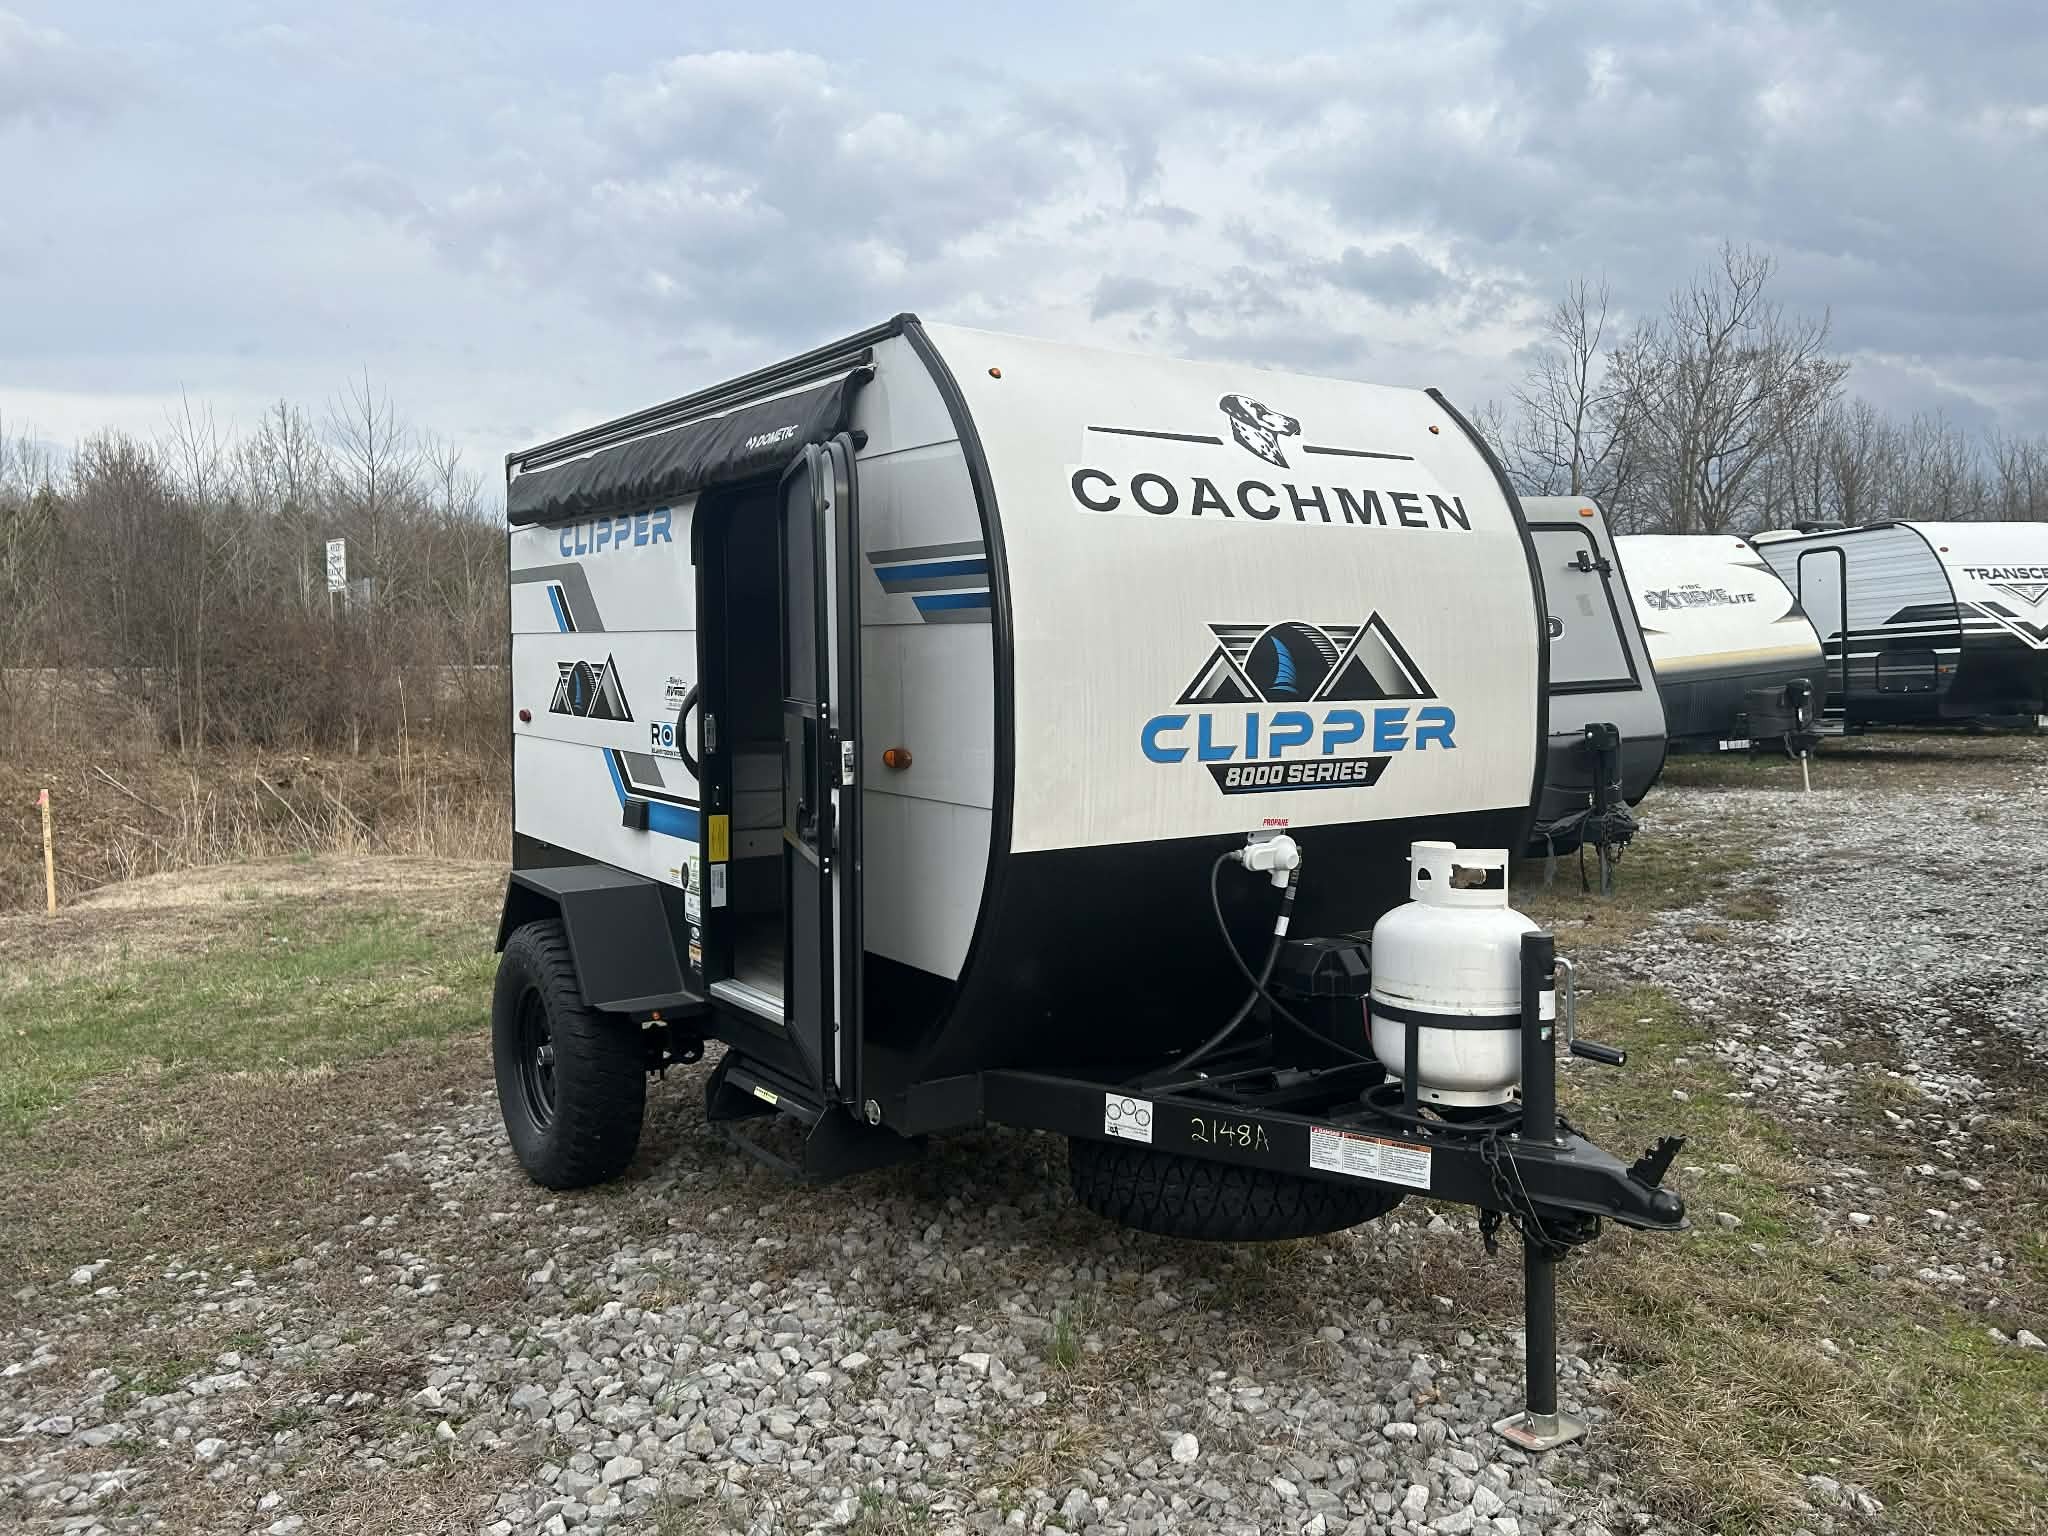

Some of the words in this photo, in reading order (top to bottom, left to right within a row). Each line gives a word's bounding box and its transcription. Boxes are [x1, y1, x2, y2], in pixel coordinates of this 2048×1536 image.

[755, 424, 800, 448] DOMETIC
[1071, 467, 1472, 531] COACHMEN
[559, 505, 673, 558] CLIPPER
[1728, 592, 1756, 604] LITE
[1140, 705, 1456, 764] CLIPPER
[1225, 764, 1285, 788] 8000
[1287, 760, 1369, 783] SERIES
[1262, 818, 1289, 827] PROPANE
[1191, 1117, 1270, 1153] 2148A
